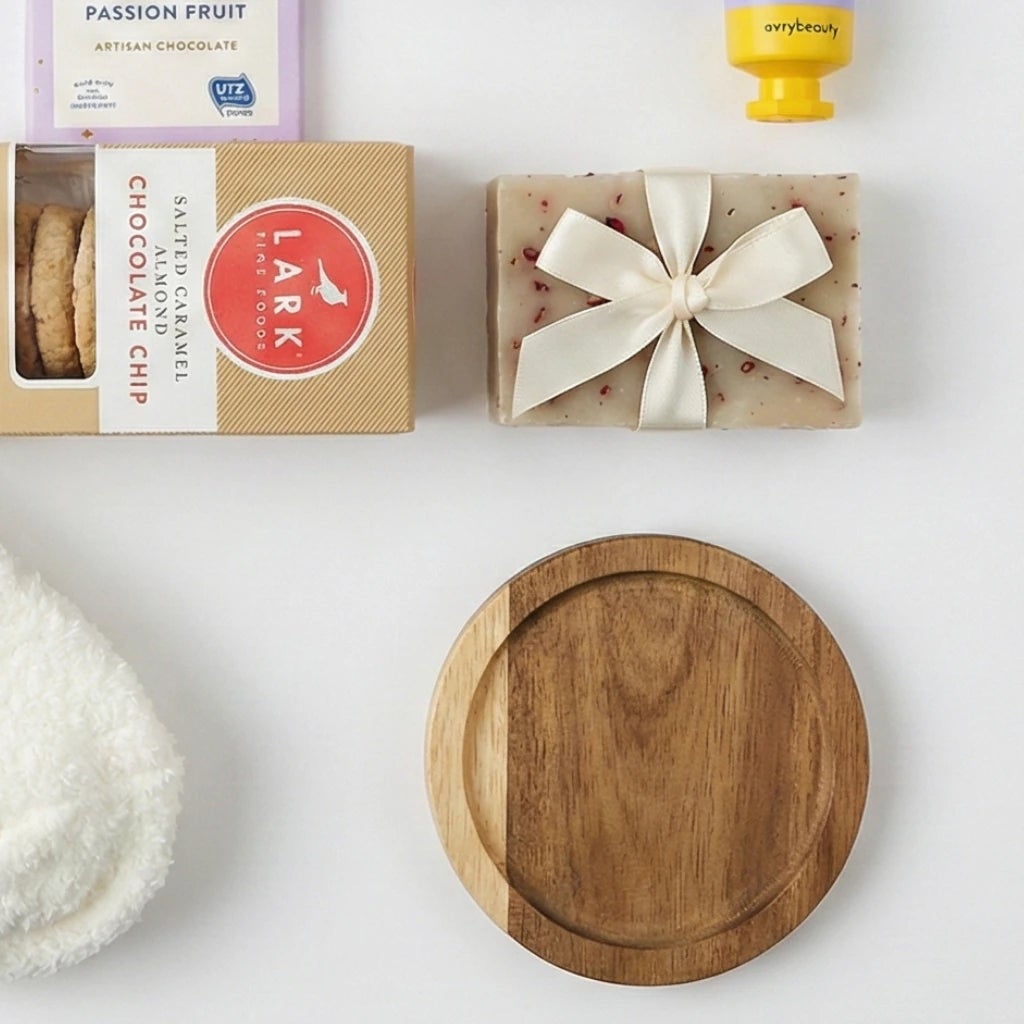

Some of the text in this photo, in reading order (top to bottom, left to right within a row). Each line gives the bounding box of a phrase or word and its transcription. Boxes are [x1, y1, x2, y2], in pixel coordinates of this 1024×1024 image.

[85, 2, 247, 21] PASSION FRUIT
[94, 40, 238, 51] ARTISAN CHOCOLATE
[215, 83, 245, 95] UTZ
[128, 175, 148, 405] CHOCOLATE CHIP
[154, 245, 168, 336] ALMOND
[174, 194, 188, 383] SALTED CARAMEL
[273, 229, 303, 349] LARK
